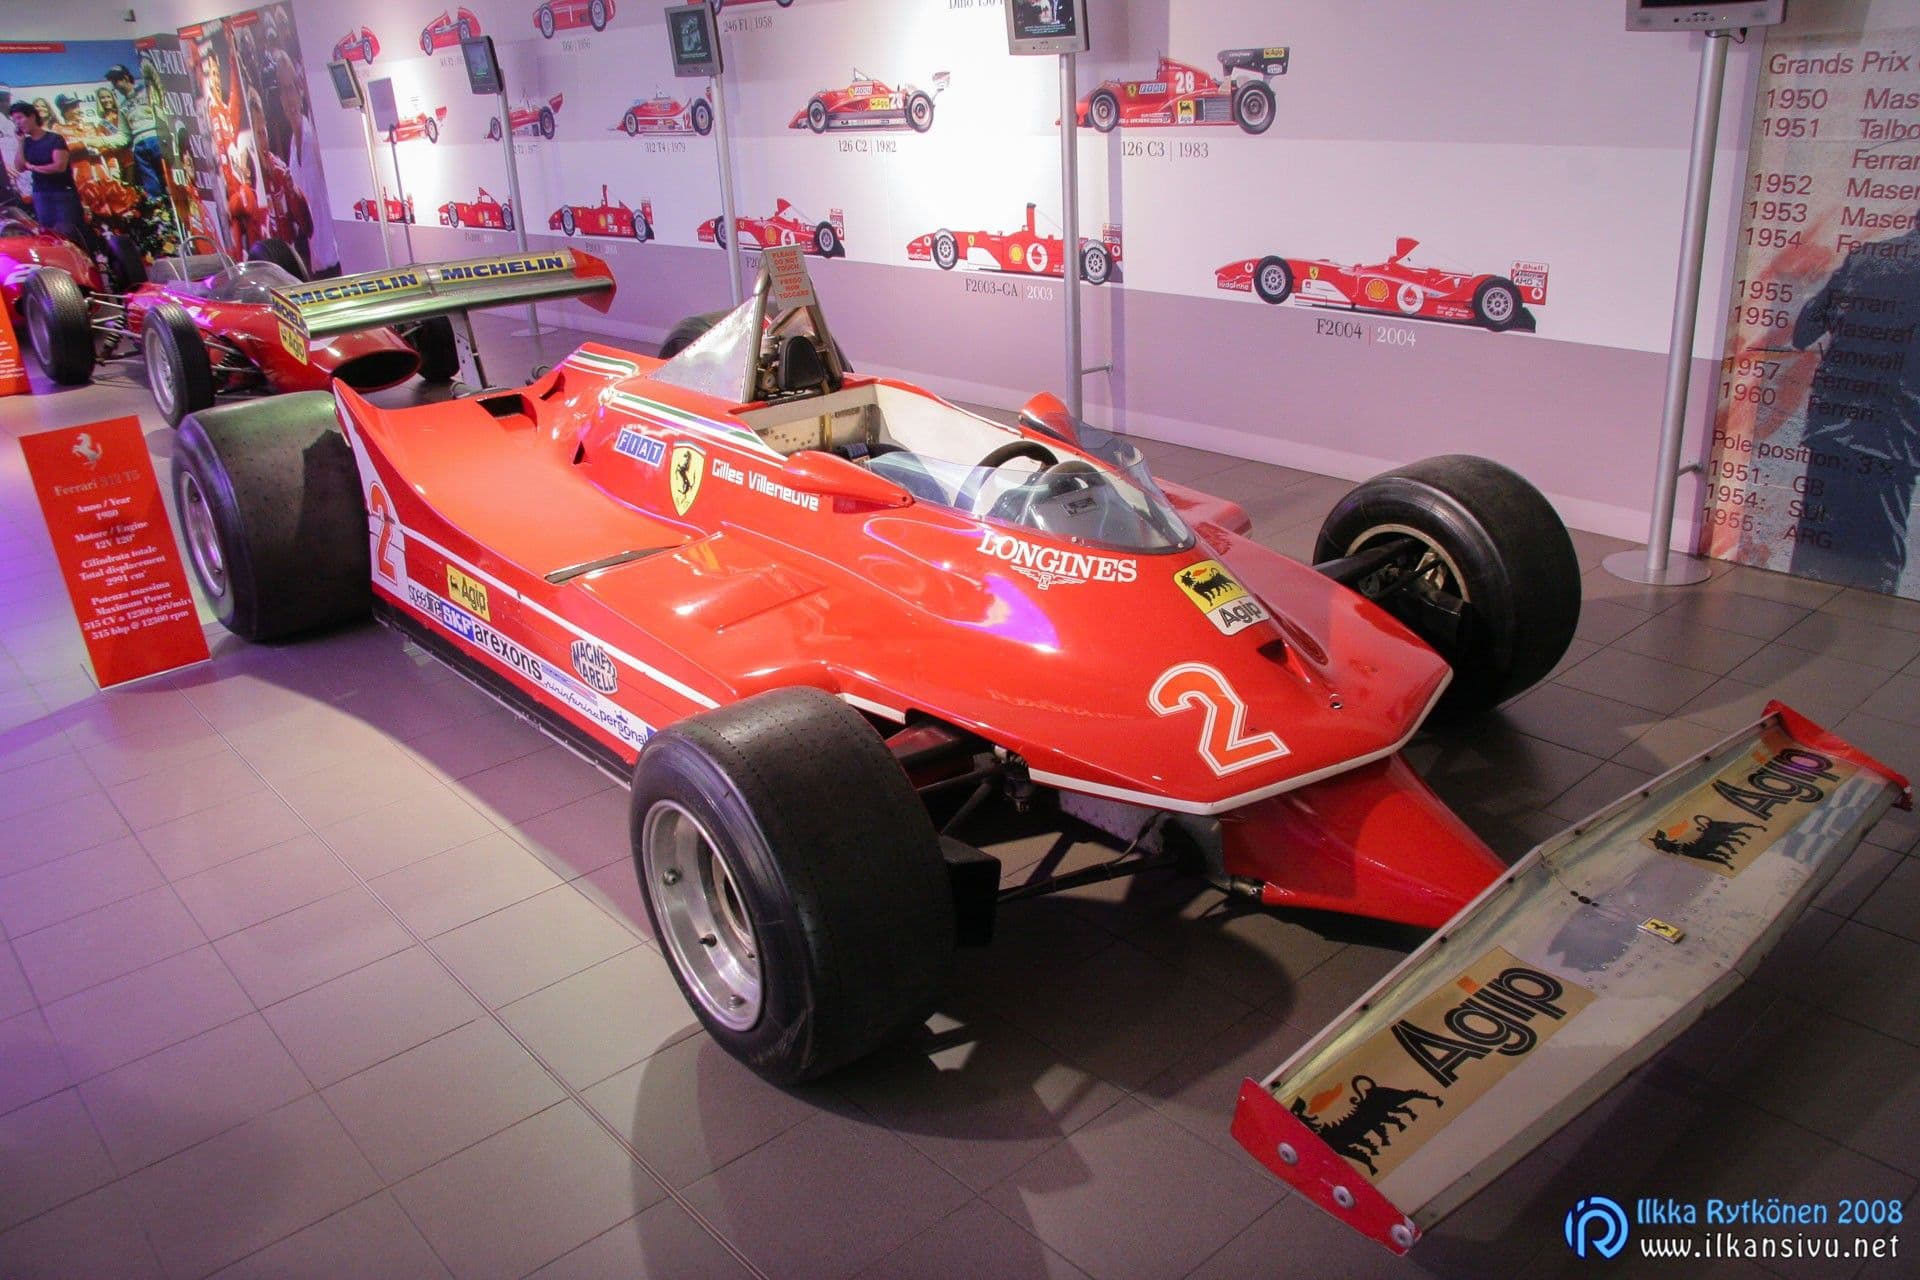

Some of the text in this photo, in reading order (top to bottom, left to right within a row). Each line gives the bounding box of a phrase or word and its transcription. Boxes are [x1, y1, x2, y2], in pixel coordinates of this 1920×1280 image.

[1768, 50, 1912, 75] Grands Prix
[1174, 71, 1195, 94] 28
[1766, 87, 1920, 110] 1950 Mas
[1762, 117, 1920, 140] 1951 Talbo
[838, 139, 898, 153] 126 C2 1982
[1121, 140, 1210, 158] 126 C3 1983
[1753, 173, 1813, 196] 1952
[1749, 200, 1808, 223] 1953
[1744, 227, 1802, 249] 1954
[771, 250, 797, 258] PLEASE
[785, 257, 799, 265] NOT
[776, 263, 799, 272] TOUCH
[288, 256, 565, 305] MICHELIN MICHELIN
[964, 278, 1054, 301] F2003-GA 2003
[1737, 279, 1794, 303] 1955
[1733, 305, 1790, 329] 1956
[1316, 317, 1417, 346] F2004 2004
[1725, 356, 1781, 380] 1957
[1721, 381, 1777, 406] 1960
[616, 431, 665, 465] FIAT
[1712, 429, 1752, 453] Pole
[54, 480, 98, 496] Ferrari
[712, 458, 819, 512] Gilles Villeneuve
[1791, 475, 1825, 498] GB
[77, 503, 102, 514] Anno
[108, 496, 131, 506] Year
[370, 480, 398, 585] 2
[1783, 525, 1833, 549] ARG
[79, 555, 166, 580] Total displacement
[976, 530, 1138, 583] LONGINES
[130, 582, 170, 596] massima
[461, 577, 487, 615] Agip
[95, 592, 173, 615] Maximum Power
[1219, 600, 1262, 628] Agip
[441, 604, 472, 635] SKF
[474, 623, 543, 681] arexons
[1147, 662, 1291, 778] 2
[1714, 748, 1841, 821] Agip
[1391, 968, 1567, 1088] Agip
